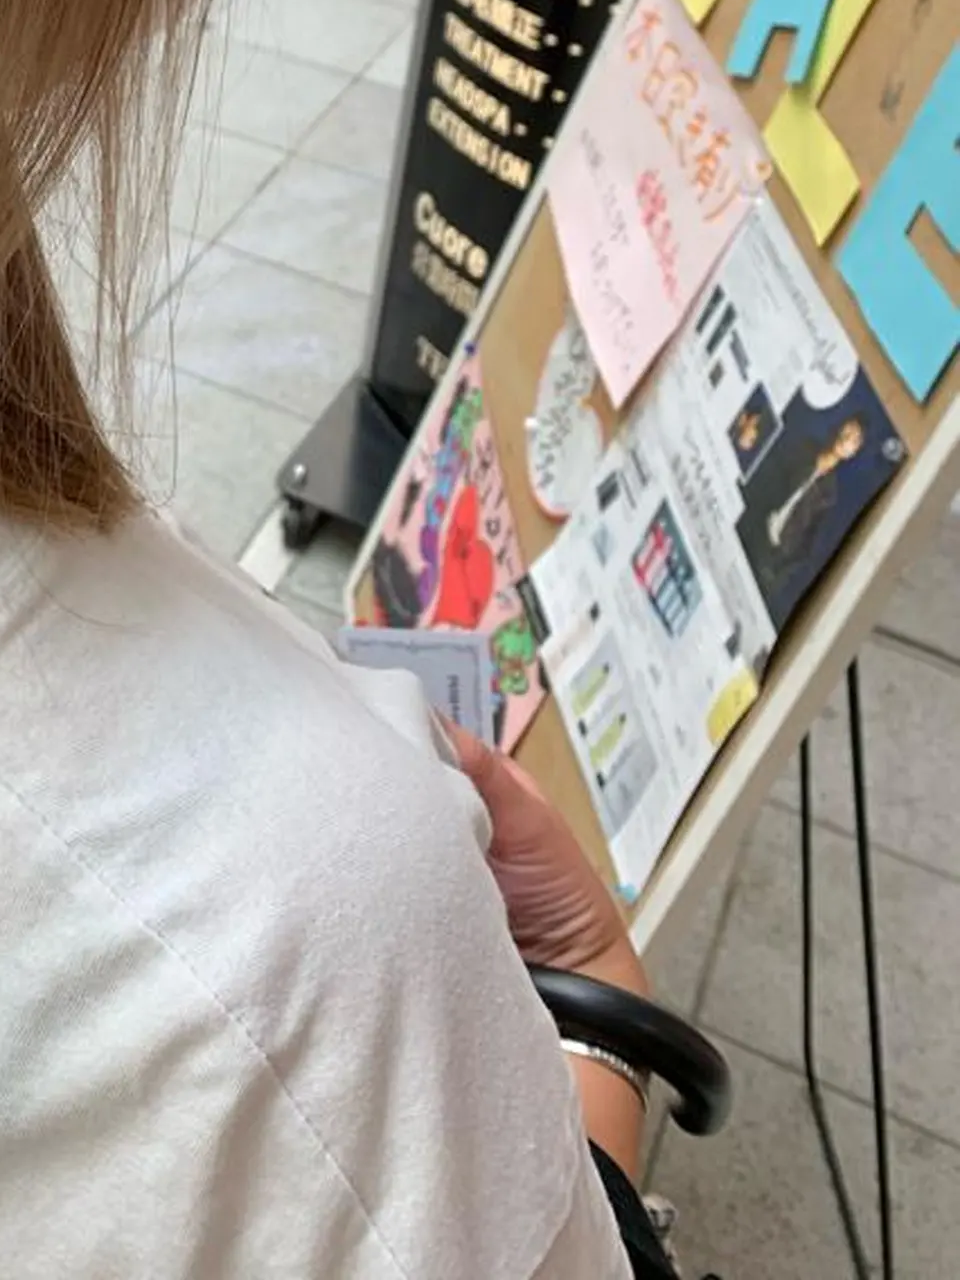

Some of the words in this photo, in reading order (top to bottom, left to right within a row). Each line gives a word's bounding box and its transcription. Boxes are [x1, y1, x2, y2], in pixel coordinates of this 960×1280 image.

[444, 11, 551, 103] TREATMENT
[427, 96, 532, 191] EXTENSION
[414, 191, 489, 279] Cuore
